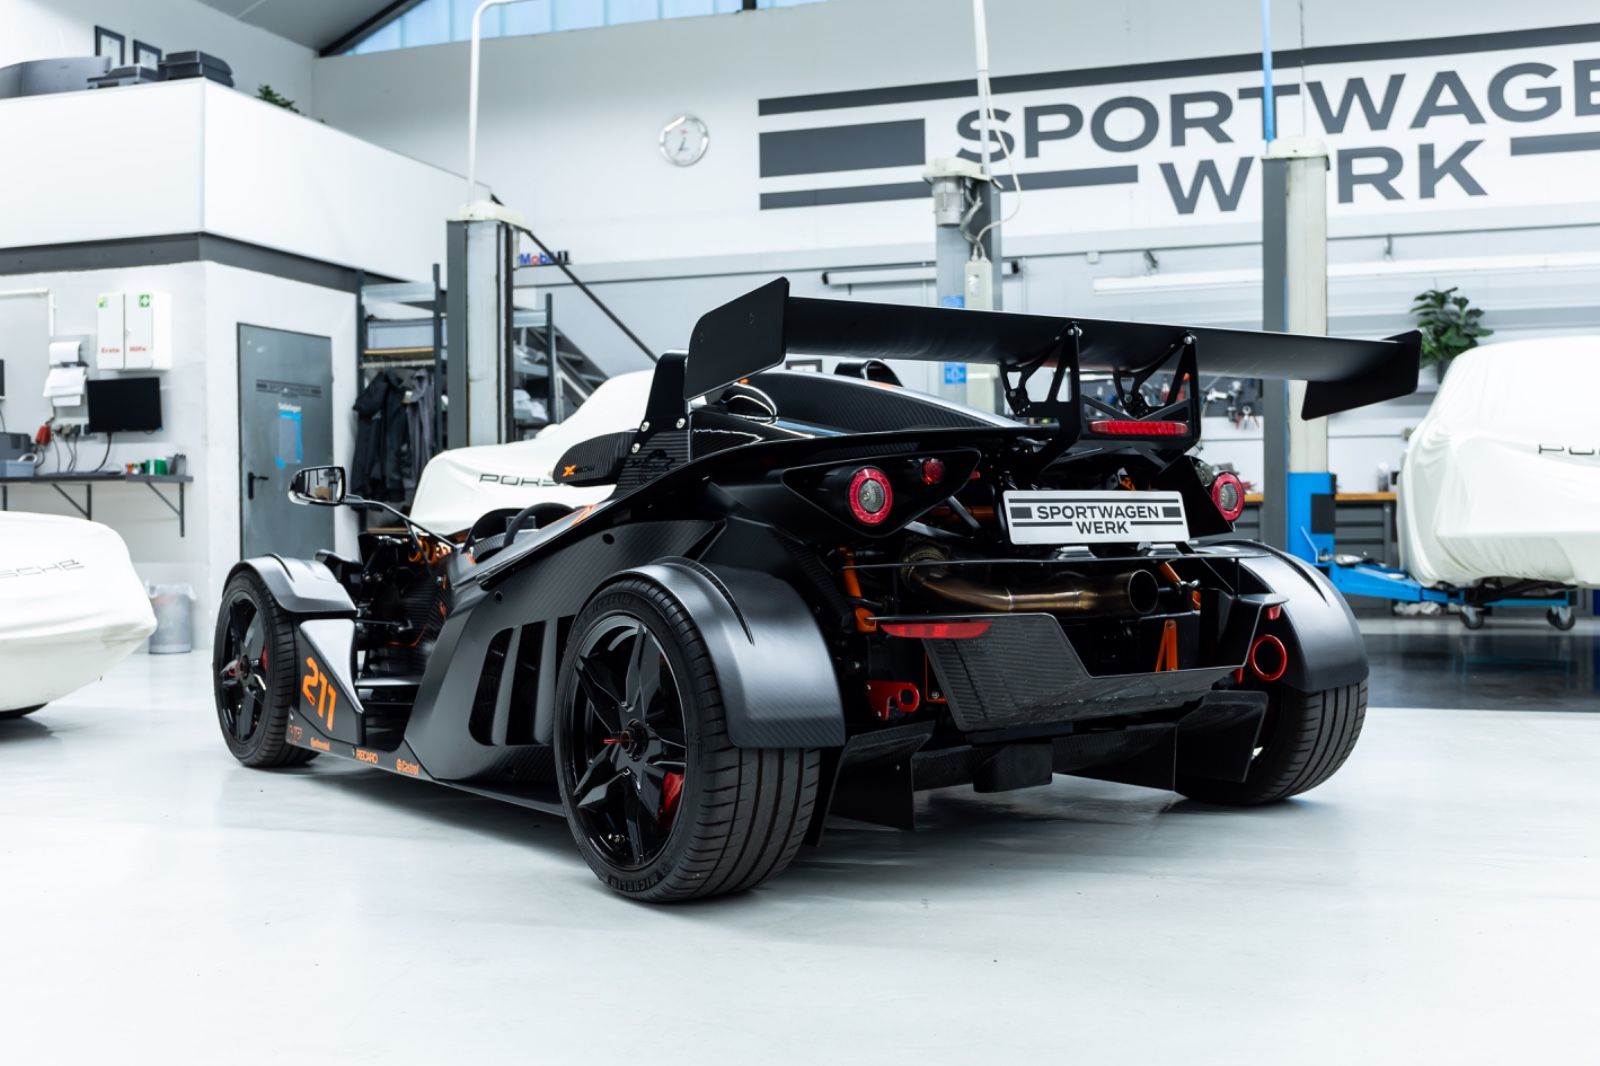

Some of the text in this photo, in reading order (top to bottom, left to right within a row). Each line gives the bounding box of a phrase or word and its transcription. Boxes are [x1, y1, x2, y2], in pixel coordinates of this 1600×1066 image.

[1158, 139, 1488, 215] WRK
[519, 251, 556, 264] Mob
[479, 473, 566, 487] PORS
[1036, 505, 1159, 520] SPORTWAGEN
[1076, 520, 1129, 534] WERK
[356, 748, 378, 764] RECARO
